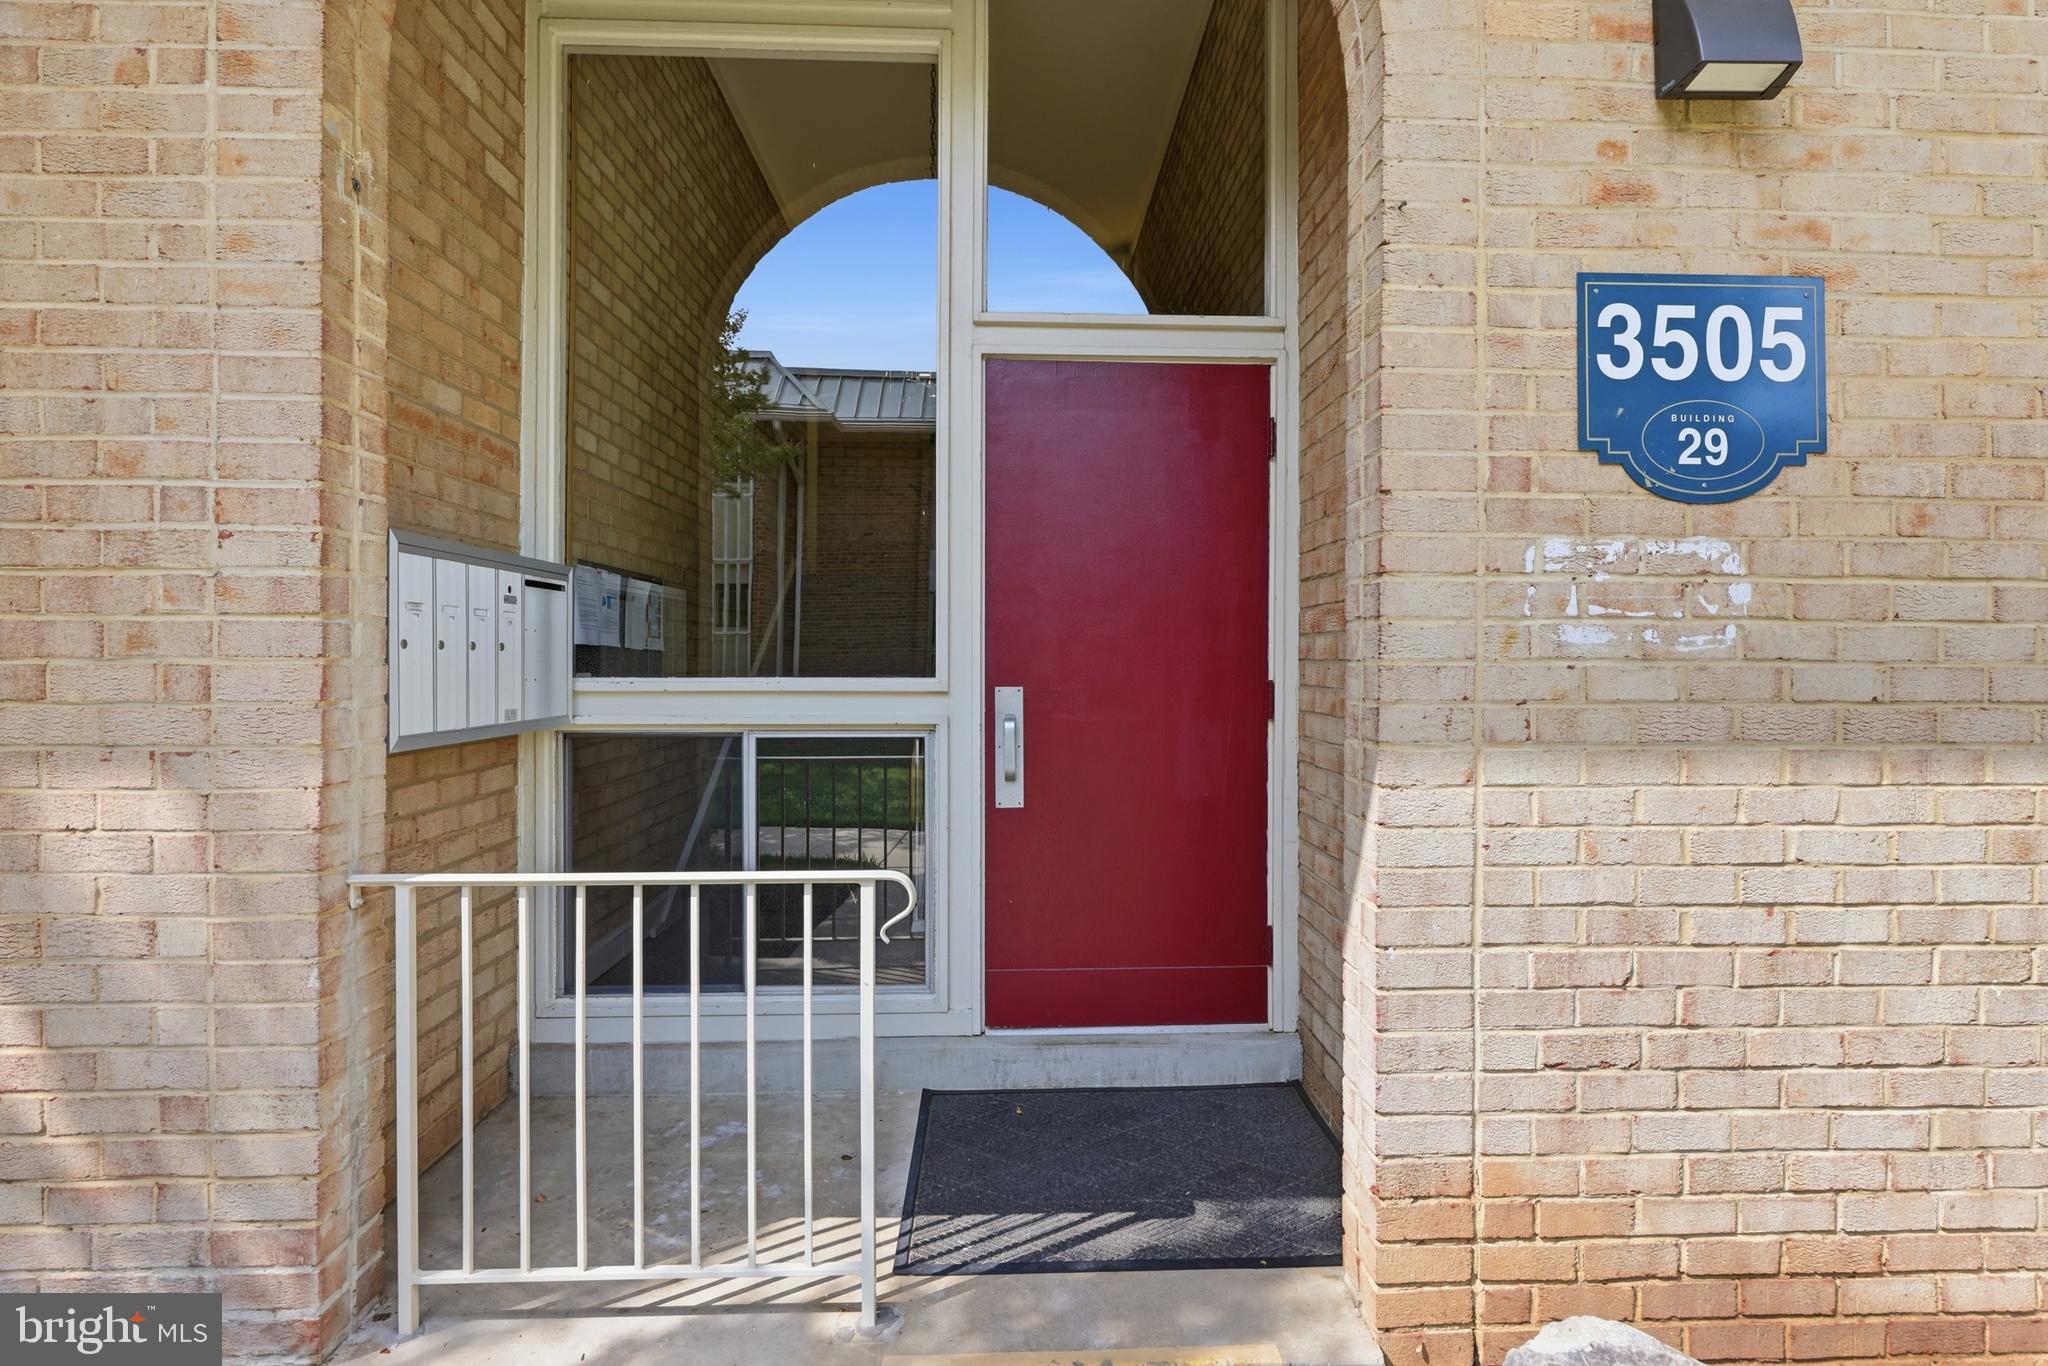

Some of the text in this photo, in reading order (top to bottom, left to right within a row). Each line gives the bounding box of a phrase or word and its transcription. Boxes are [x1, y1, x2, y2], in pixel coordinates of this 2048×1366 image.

[1596, 302, 1806, 382] 3505
[1670, 413, 1736, 423] BUILDING
[1678, 427, 1729, 466] 29
